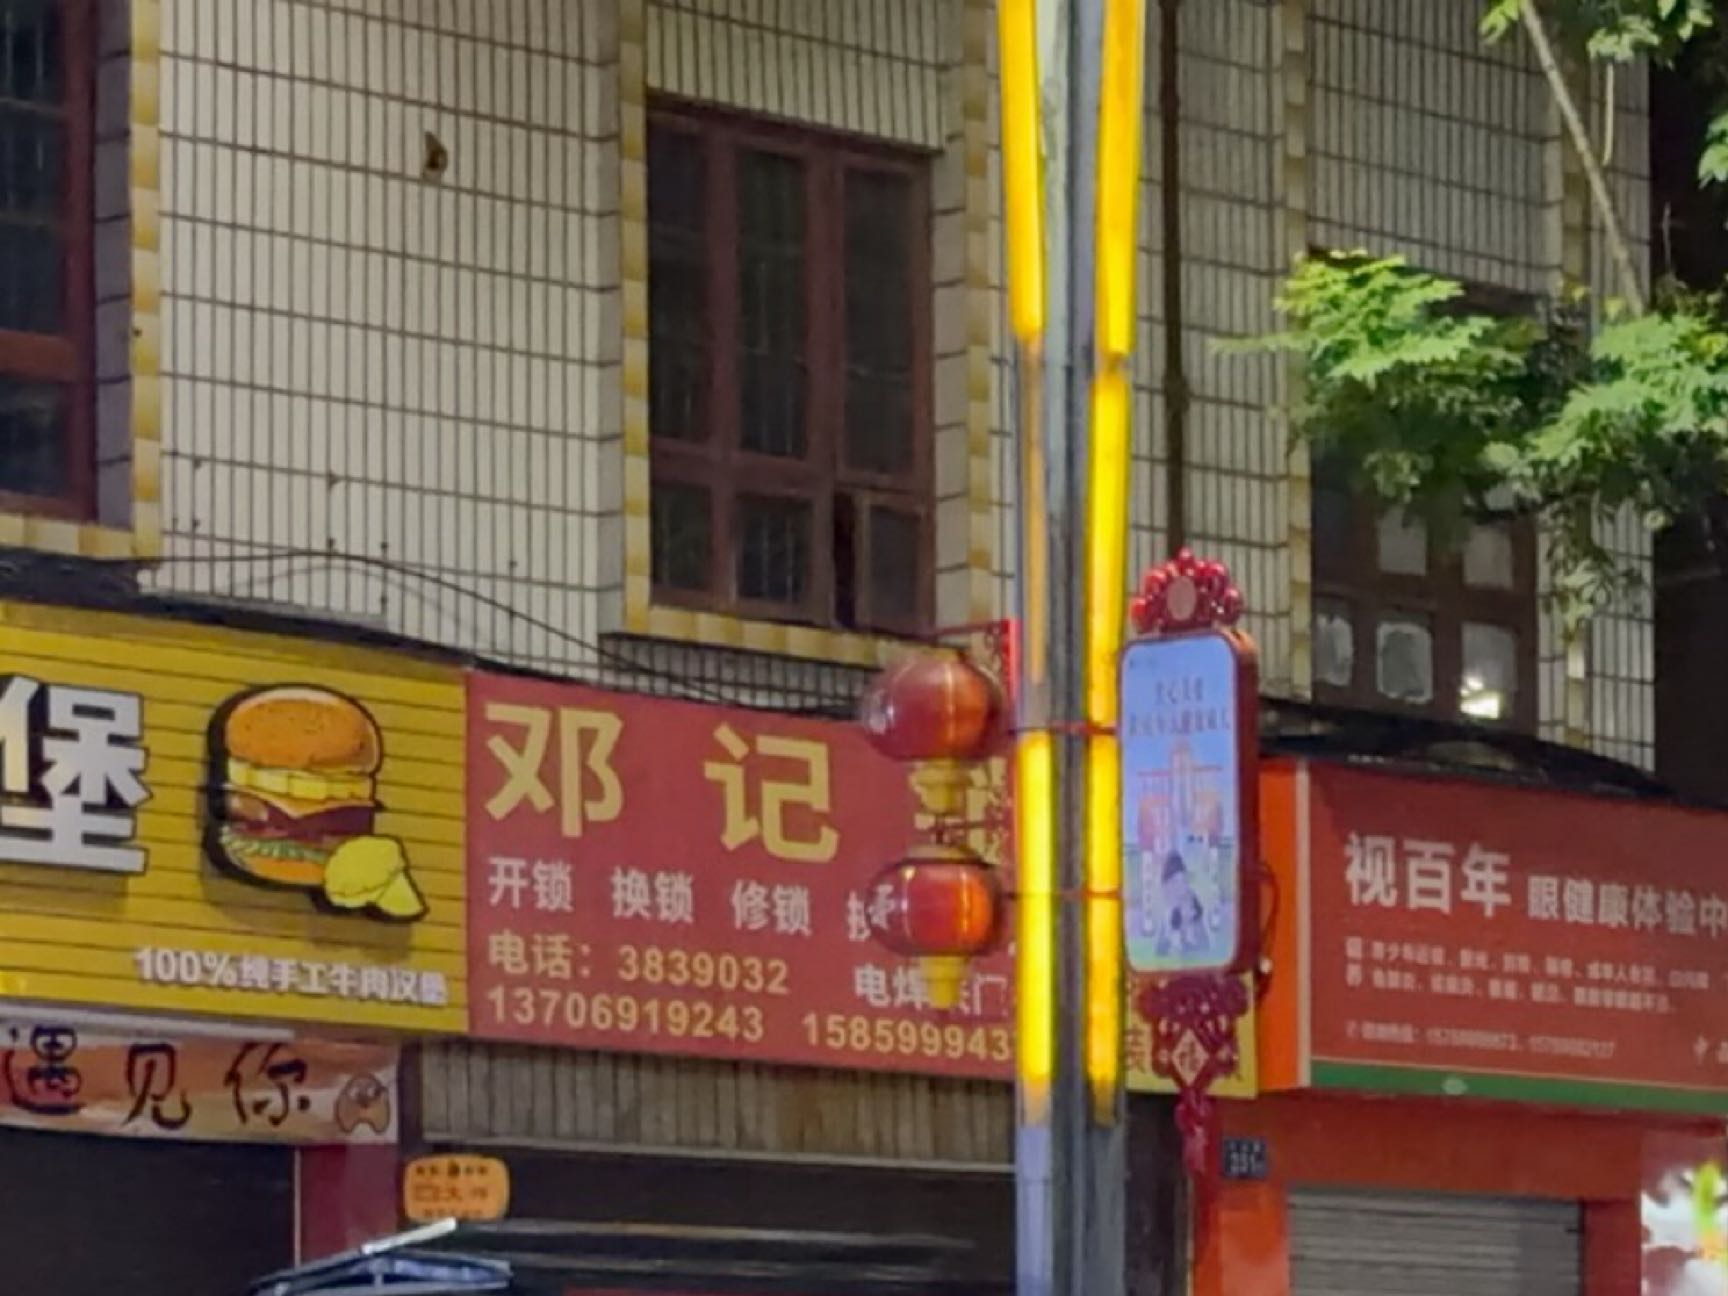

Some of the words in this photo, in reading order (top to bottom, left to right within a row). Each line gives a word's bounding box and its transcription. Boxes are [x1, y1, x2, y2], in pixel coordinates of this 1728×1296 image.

[0, 674, 152, 874] 堡
[488, 856, 575, 914] 开锁
[610, 865, 695, 924] 换锁
[731, 877, 813, 937] 修锁
[1344, 831, 1512, 918] 视百年
[617, 944, 790, 995] 3839032
[486, 983, 765, 1043] 13706919243
[802, 1011, 1012, 1063] 158599943
[1, 1024, 312, 1129] 遇见你
